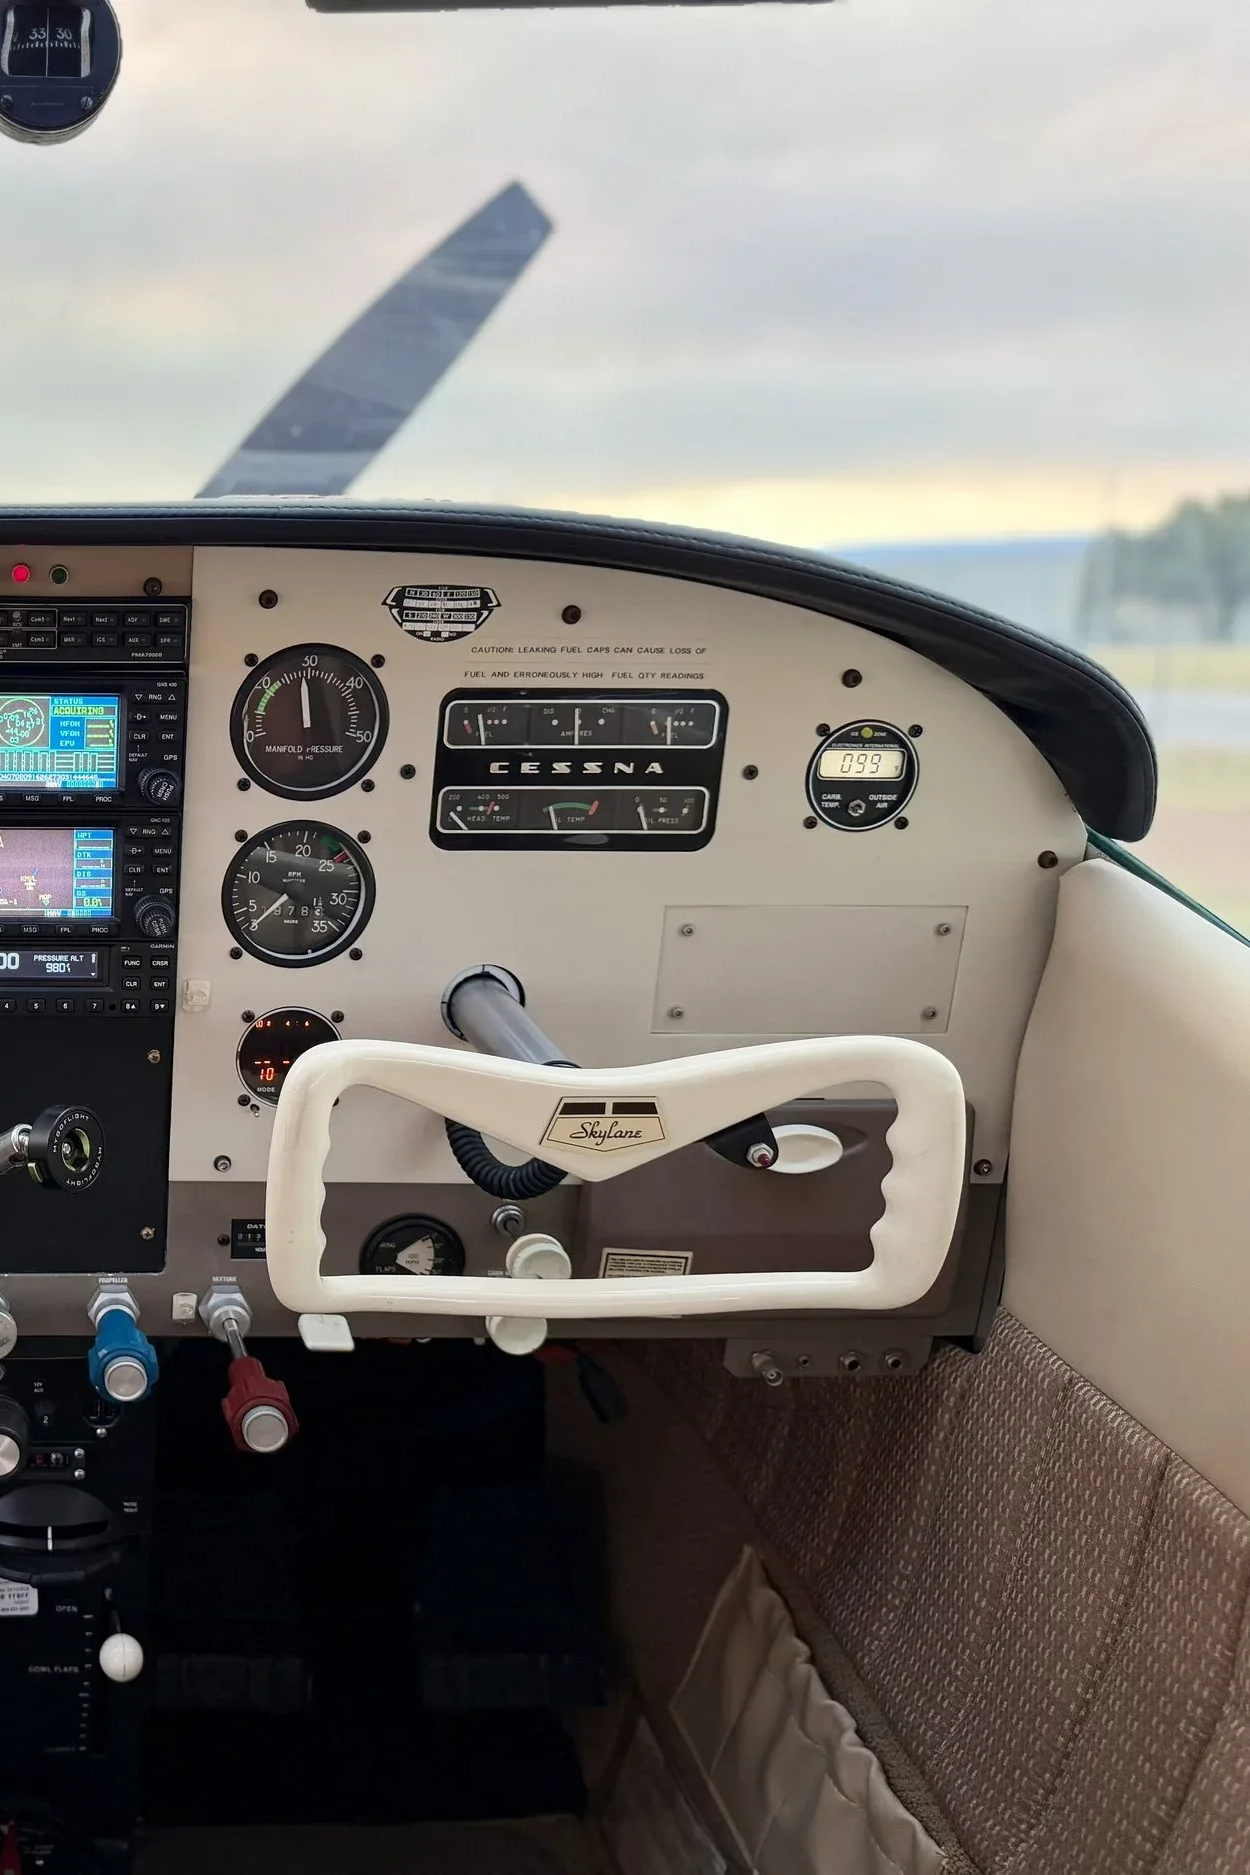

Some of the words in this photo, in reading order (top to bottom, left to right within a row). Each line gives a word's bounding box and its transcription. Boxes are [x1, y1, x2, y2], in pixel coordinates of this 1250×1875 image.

[29, 28, 46, 40] 33
[56, 28, 72, 40] 30
[302, 655, 318, 667] 30
[346, 677, 363, 689] 40
[54, 706, 104, 714] ACQUIRING
[355, 731, 371, 743] 50
[489, 762, 664, 774] CESSNA
[840, 753, 881, 773] 099
[266, 851, 277, 863] 15
[295, 845, 311, 857] 20
[319, 860, 334, 871] 25
[248, 871, 260, 883] 10
[159, 887, 173, 895] GPS
[330, 893, 347, 905] 30
[249, 900, 257, 911] 5
[312, 921, 328, 932] 35
[33, 954, 69, 962] PRESSURE
[260, 1068, 274, 1080] 10
[53, 1113, 89, 1152] MYGOFLIGHT
[569, 1121, 642, 1146] Skylane
[66, 1147, 101, 1186] MYGOFLIGHT
[43, 1415, 49, 1424] 2
